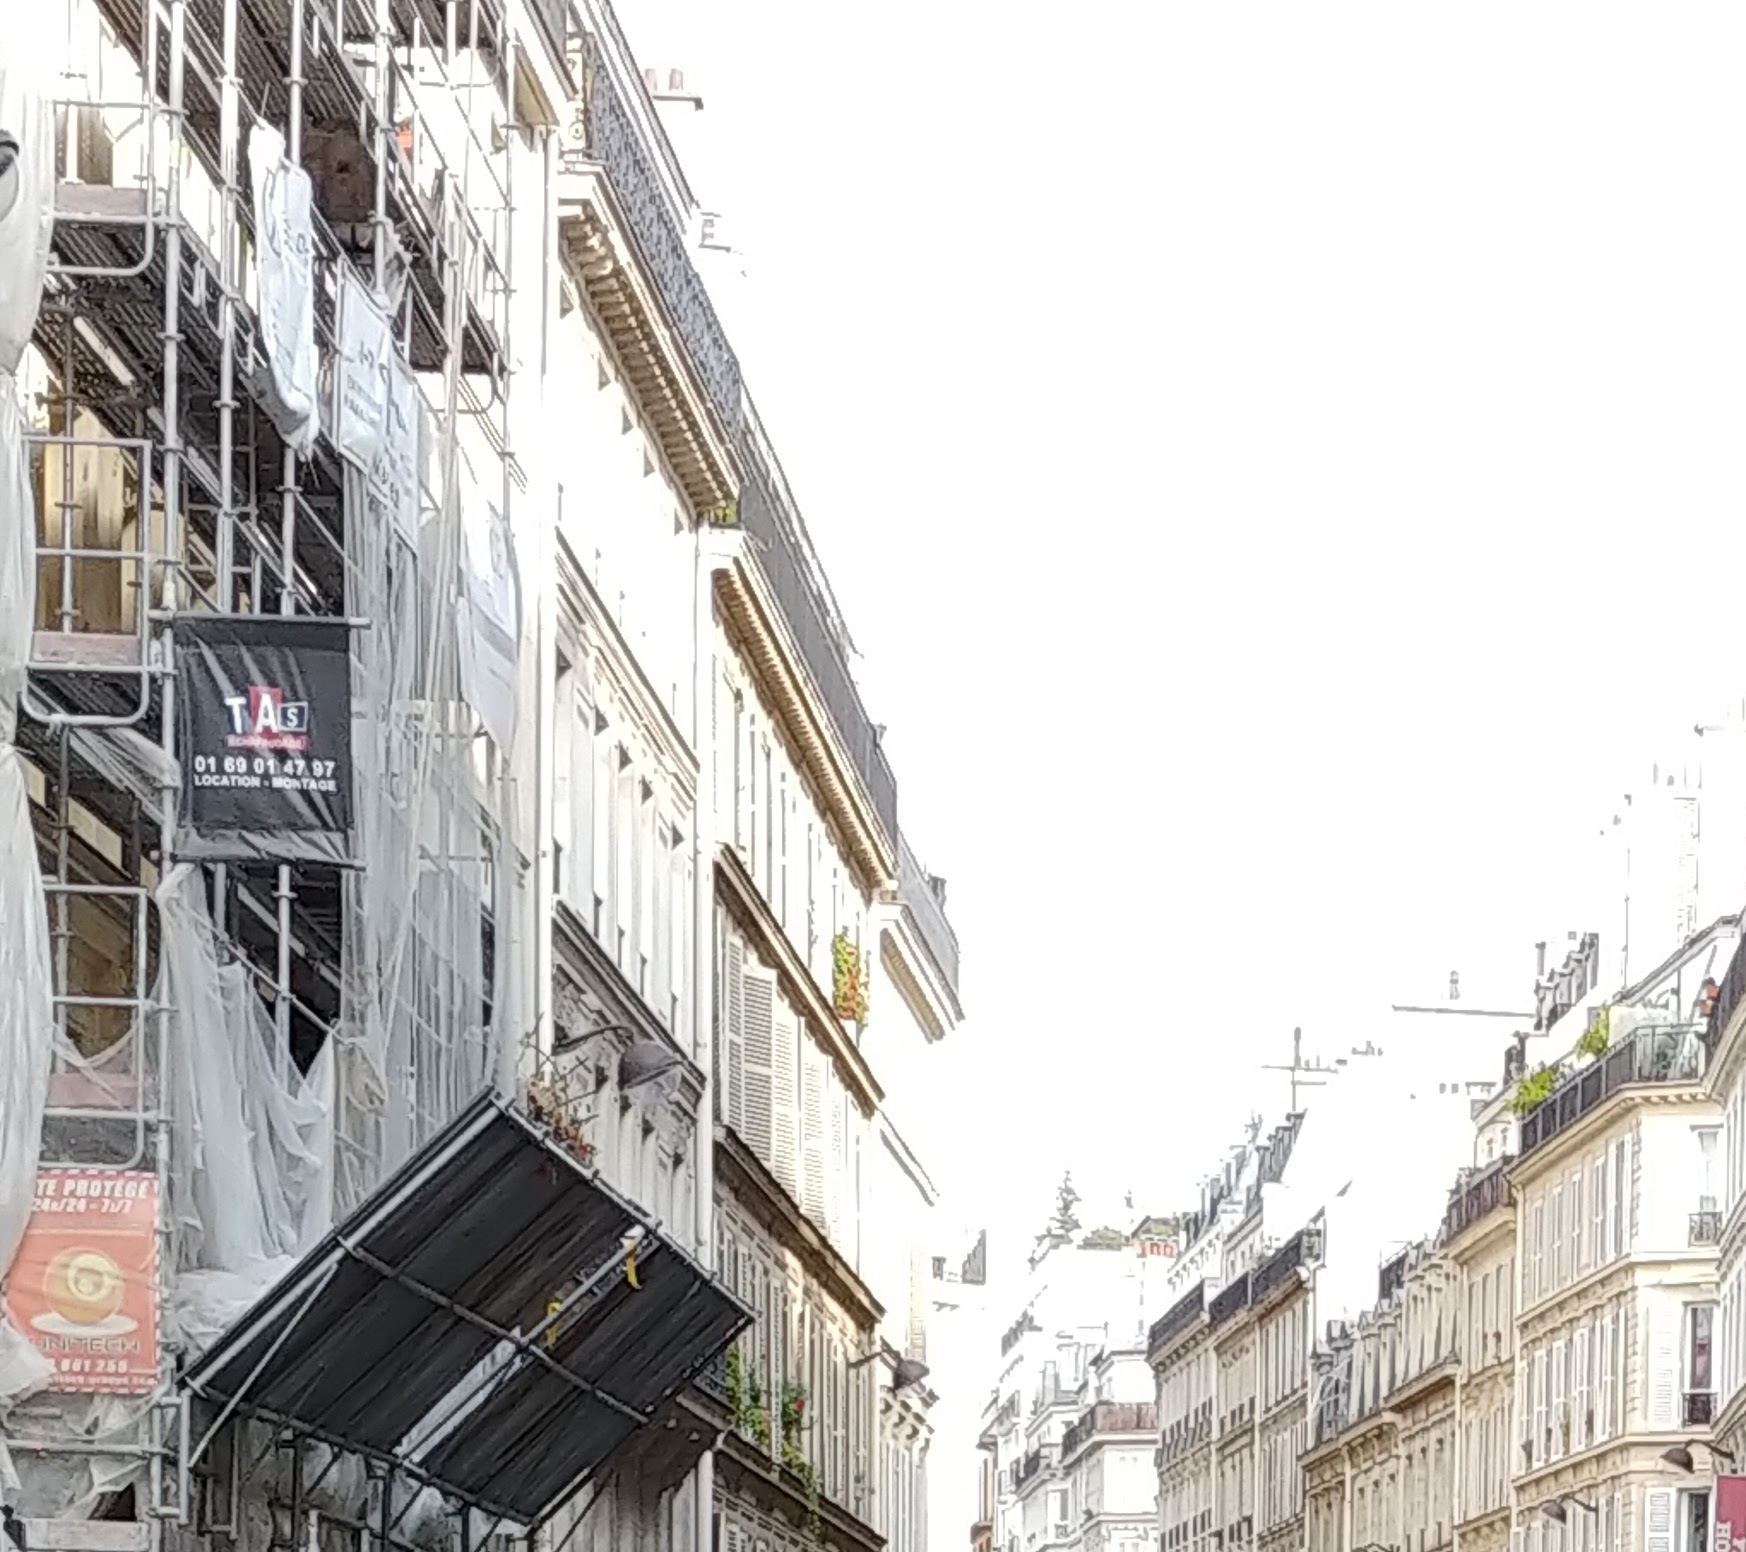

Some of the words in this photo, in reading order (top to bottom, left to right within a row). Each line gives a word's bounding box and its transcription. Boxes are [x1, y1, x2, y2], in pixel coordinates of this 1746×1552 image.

[224, 692, 300, 734] TAS
[194, 755, 217, 773] 01
[224, 757, 248, 774] 69
[253, 758, 276, 775] 01
[283, 760, 306, 776] 47
[312, 761, 336, 778] 97
[194, 774, 261, 788] LOCATION
[272, 777, 337, 792] MONTAGE
[42, 1336, 140, 1353] NITECH
